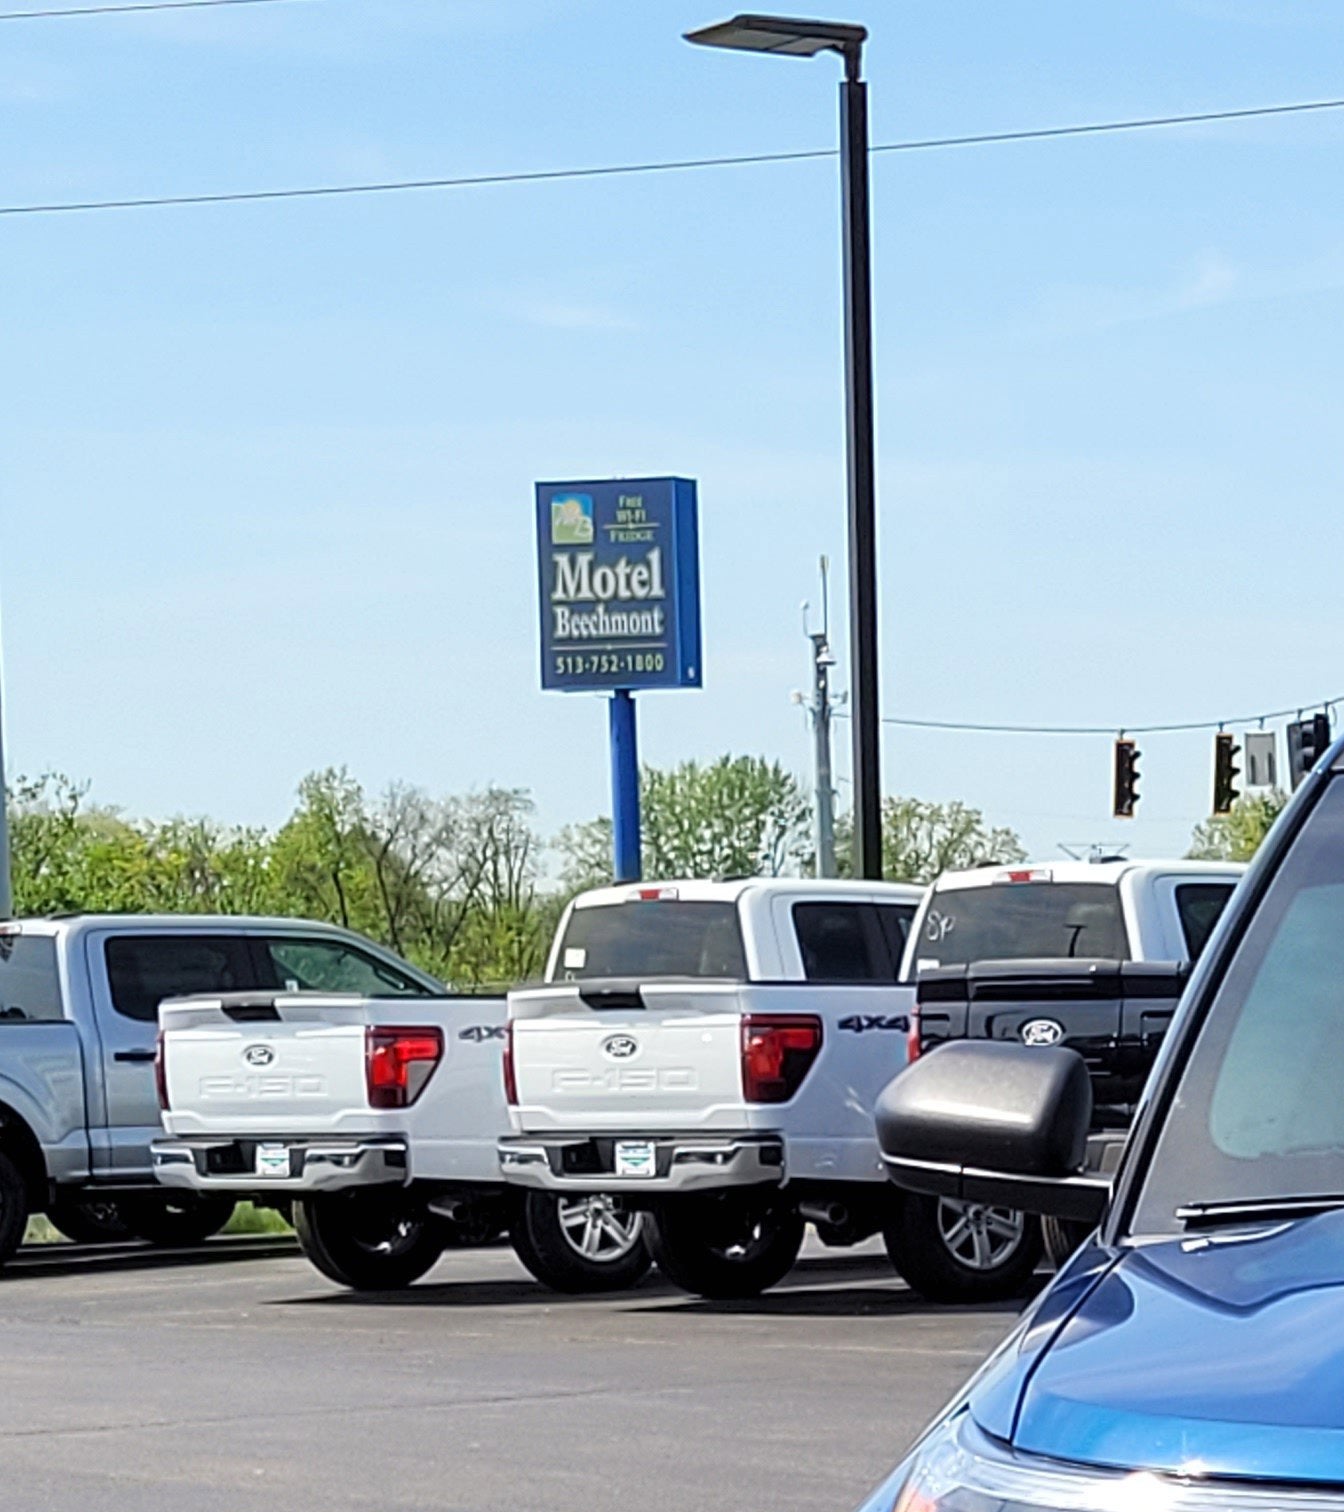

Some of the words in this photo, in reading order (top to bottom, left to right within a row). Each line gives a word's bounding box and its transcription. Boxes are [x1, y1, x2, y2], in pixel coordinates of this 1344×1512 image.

[551, 546, 665, 600] Motel
[553, 603, 664, 638] Beechmont
[200, 1074, 328, 1099] F-150
[552, 1066, 699, 1092] F-150
